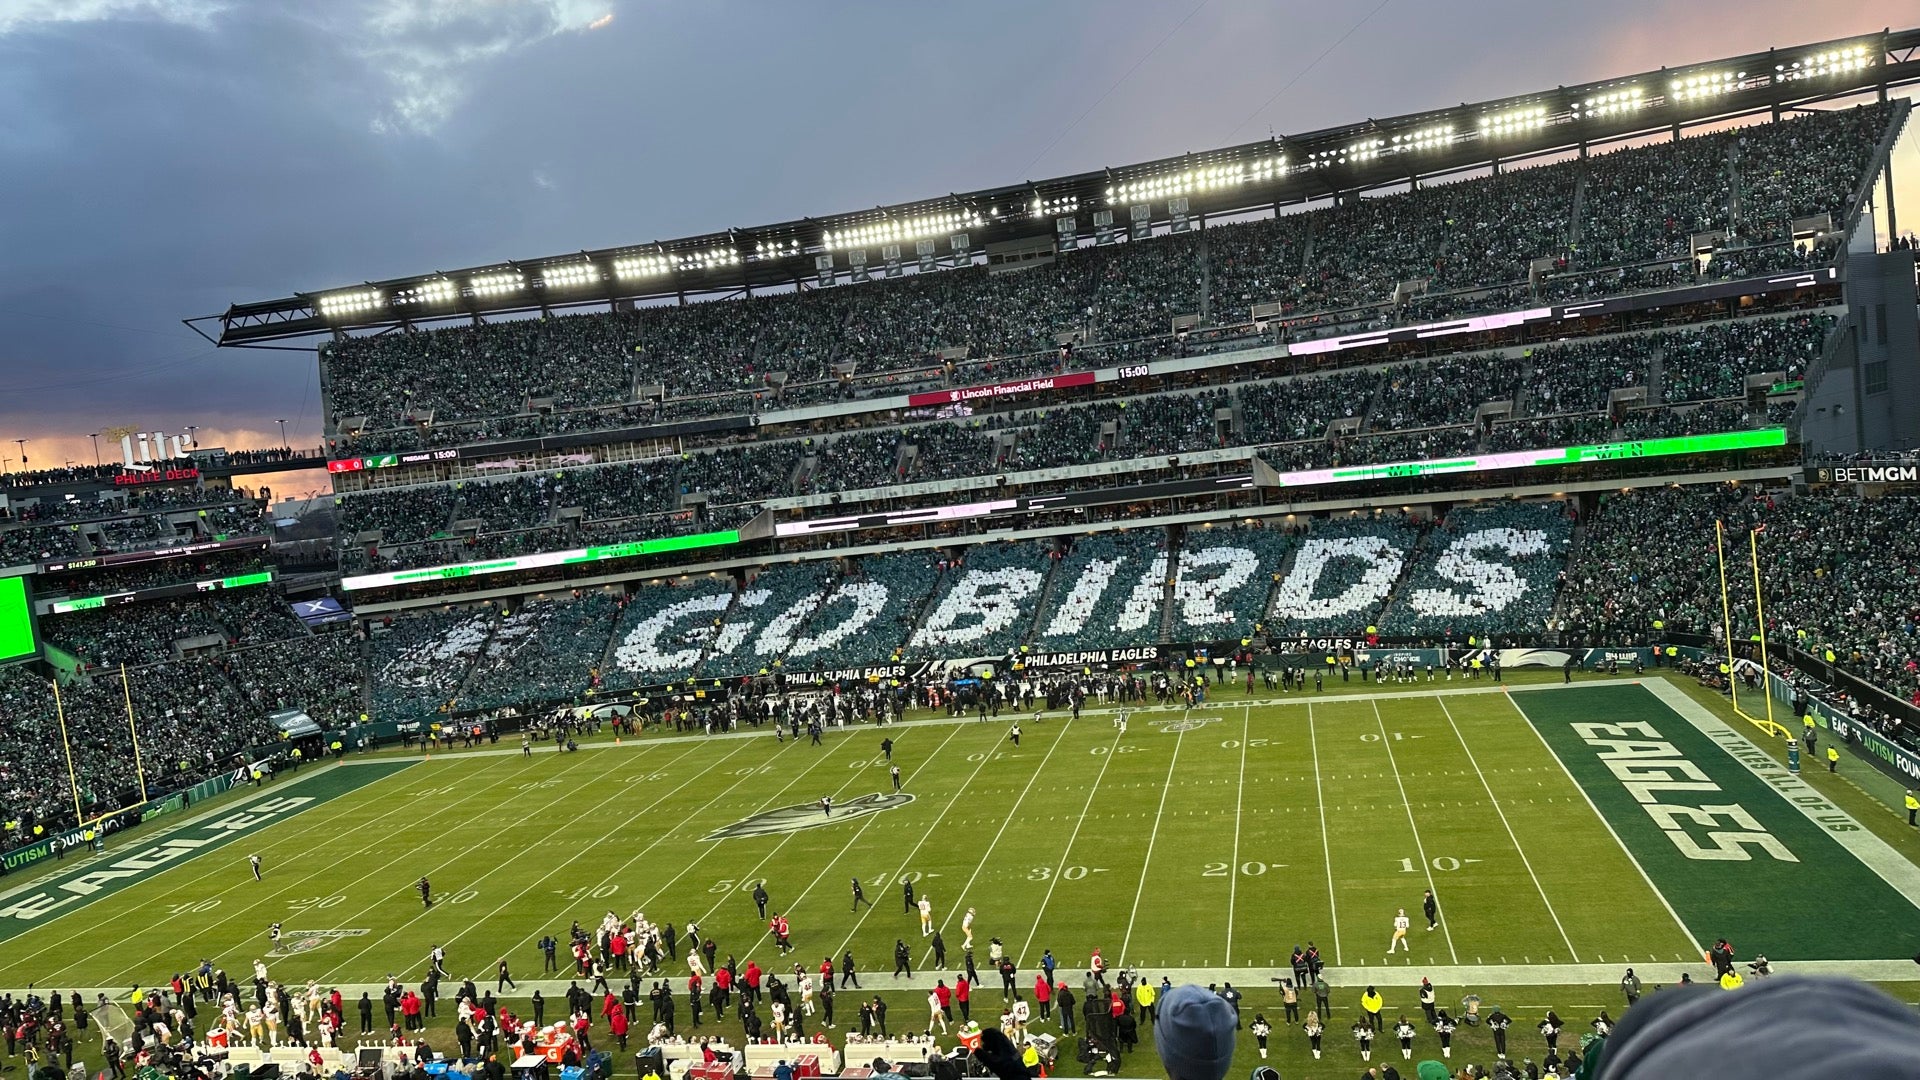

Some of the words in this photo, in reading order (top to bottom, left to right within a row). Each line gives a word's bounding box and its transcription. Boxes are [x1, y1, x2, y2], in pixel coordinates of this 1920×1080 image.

[1119, 365, 1149, 378] 15:00
[962, 388, 993, 400] Lincoln
[994, 383, 1032, 395] Financial
[1033, 378, 1054, 390] Field
[121, 431, 192, 472] Lite
[402, 453, 430, 463] PREGAME
[433, 450, 457, 460] 15:00
[1595, 442, 1643, 460] WIN
[365, 459, 373, 467] 0
[115, 471, 162, 486] PHLITE
[166, 468, 200, 481] DECK
[1834, 466, 1917, 482] BETMGM
[610, 542, 645, 557] WIN
[614, 580, 889, 673] GO
[907, 527, 1551, 648] BIRDS
[1300, 638, 1352, 650] EAGLES
[1024, 650, 1108, 668] PHILADELPHIA
[1111, 647, 1158, 662] EAGLES
[863, 665, 906, 680] EAGLES
[1707, 729, 1738, 738] IT
[1831, 716, 1863, 742] EAGS
[1863, 735, 1895, 766] AUTISM
[1722, 740, 1778, 770] TAKES
[1761, 773, 1807, 793] ALL
[1569, 720, 1801, 863] EAGLES
[1792, 796, 1834, 811] OF
[1816, 815, 1860, 832] US
[49, 815, 126, 853] FOUNTIO
[0, 796, 317, 920] EAGLES
[1394, 856, 1461, 873] 10
[1026, 866, 1089, 881] 30
[1201, 861, 1267, 877] 20
[707, 878, 768, 894] 50
[863, 871, 923, 887] 40
[1016, 1005, 1027, 1015] 47
[970, 1039, 979, 1049] G
[547, 1048, 558, 1060] G
